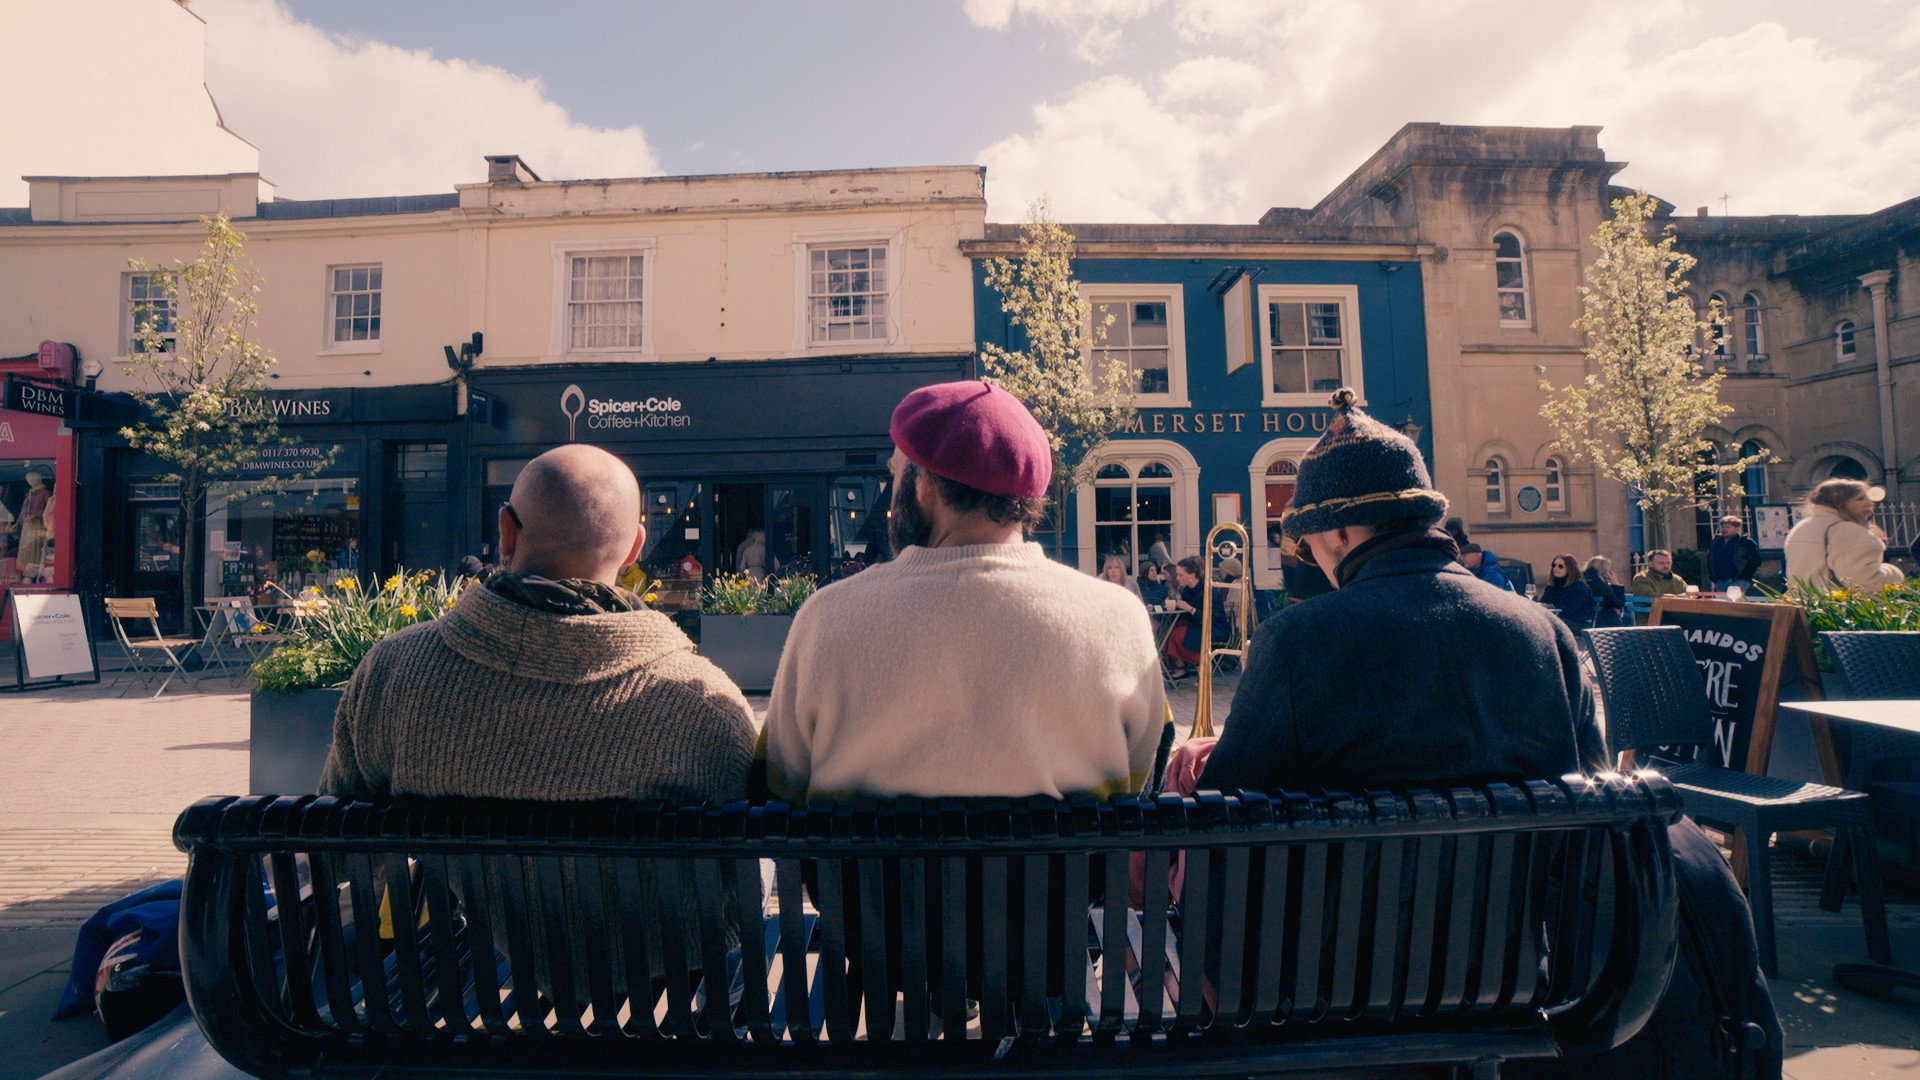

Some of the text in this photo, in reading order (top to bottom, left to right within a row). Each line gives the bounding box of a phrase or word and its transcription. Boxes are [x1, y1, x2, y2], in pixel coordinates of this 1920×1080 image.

[21, 386, 64, 405] DBM
[21, 399, 64, 415] WINES
[271, 399, 330, 416] WINES
[588, 397, 682, 416] Spicer+Cole
[588, 413, 691, 429] Coffee+Kitchen
[1080, 412, 1328, 434] OMERSET HOU
[262, 447, 320, 457] 0117 370 9930
[1684, 629, 1763, 661] ANDOS
[1696, 659, 1742, 708] 'RE
